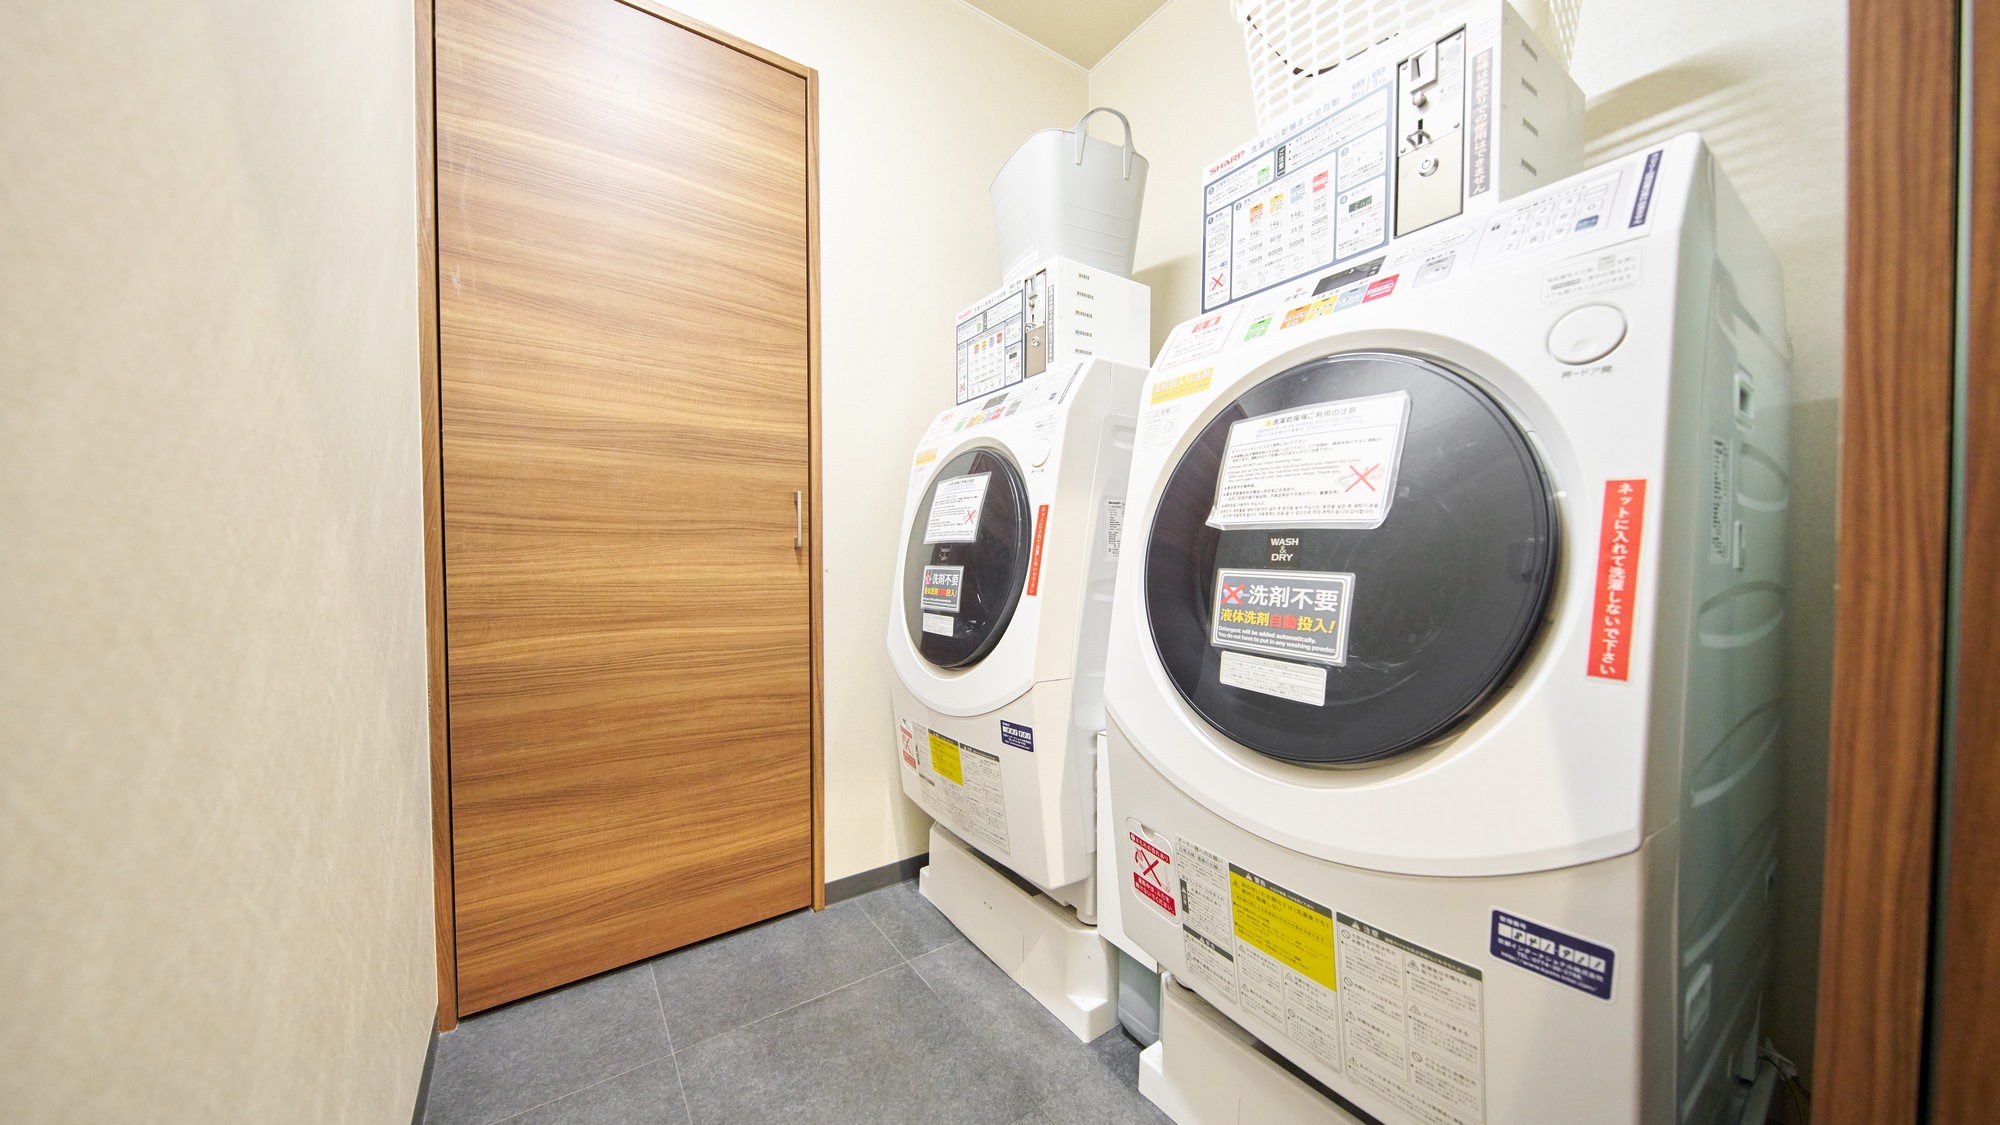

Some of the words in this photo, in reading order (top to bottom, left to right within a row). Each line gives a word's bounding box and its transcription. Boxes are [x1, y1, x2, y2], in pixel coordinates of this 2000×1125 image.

[1209, 150, 1245, 176] SHARP
[1313, 201, 1327, 212] 30分
[1311, 214, 1329, 227] 200円
[1290, 224, 1304, 234] 35分
[1269, 233, 1282, 243] 80分
[1287, 237, 1305, 249] 500円
[1248, 242, 1263, 252] 120分
[1267, 246, 1284, 257] 600円
[1271, 538, 1299, 546] WASH
[1271, 553, 1294, 561] DRY
[931, 573, 960, 586] 洗剤不要
[1600, 483, 1633, 675] ネットに入れて洗濯しないで下さい
[1248, 584, 1340, 613] 洗剤不要
[1221, 608, 1336, 634] 液体洗剤自動投入!
[1218, 625, 1241, 633] Detergent
[1276, 633, 1316, 644] automatically.
[1286, 642, 1310, 650] washing
